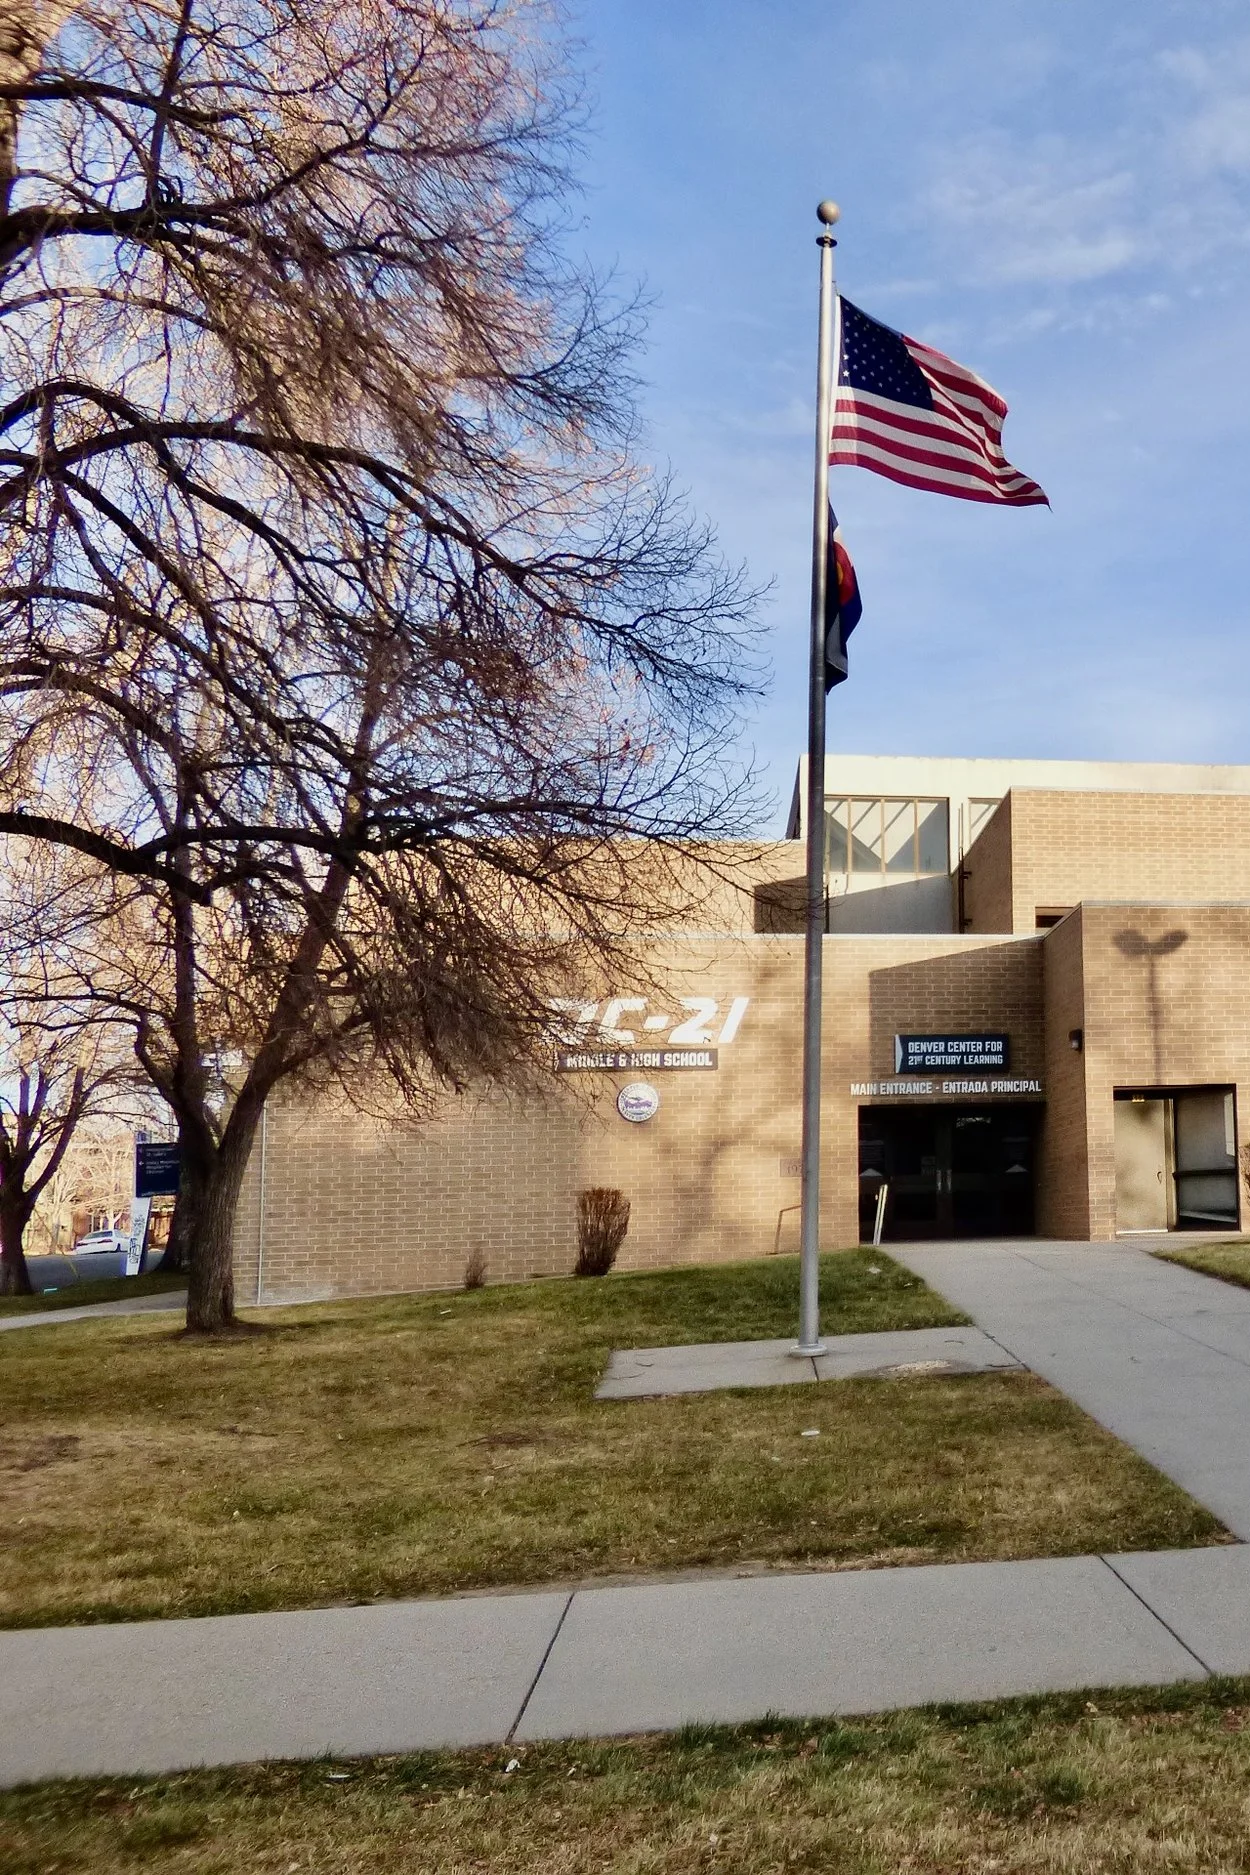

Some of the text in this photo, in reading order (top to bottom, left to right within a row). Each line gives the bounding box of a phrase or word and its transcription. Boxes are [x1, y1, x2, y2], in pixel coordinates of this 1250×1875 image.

[908, 1041, 1003, 1053] DENVER CENTER FOR
[618, 1053, 627, 1067] &
[631, 1052, 660, 1067] HIGH
[664, 1052, 713, 1067] SCHOOL
[925, 1055, 961, 1065] CENTURY
[963, 1054, 1003, 1065] LEARNING
[850, 1083, 877, 1096] MAIN
[880, 1081, 933, 1095] ENTRANCE
[942, 1081, 988, 1094] ENTRADA
[991, 1080, 1042, 1093] PRINCIPAL
